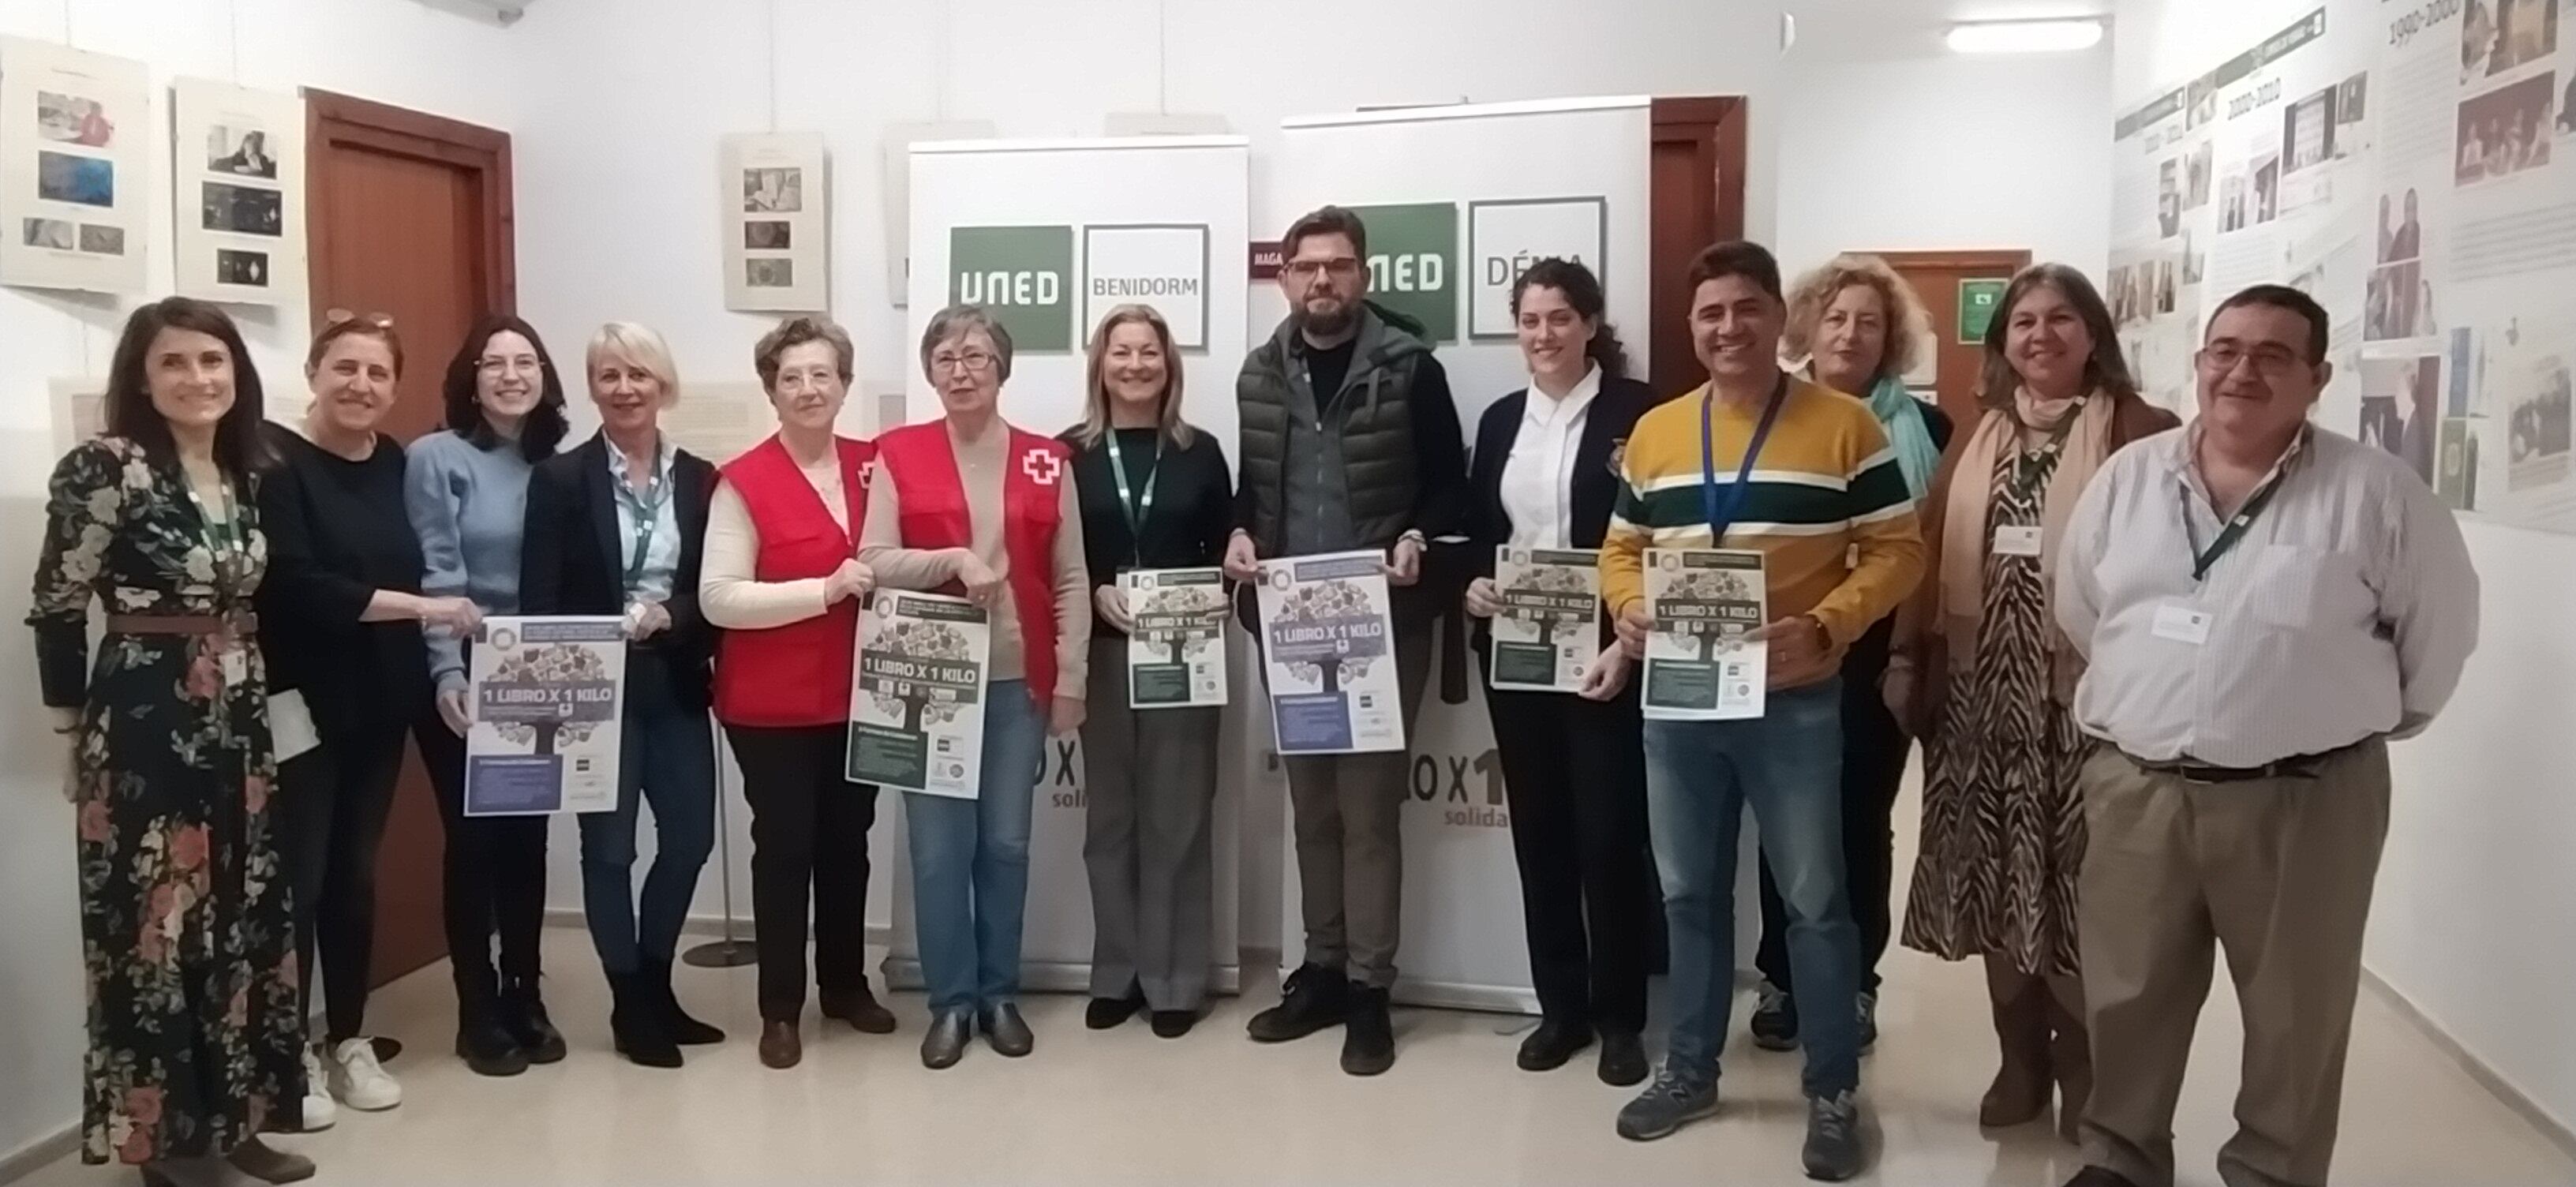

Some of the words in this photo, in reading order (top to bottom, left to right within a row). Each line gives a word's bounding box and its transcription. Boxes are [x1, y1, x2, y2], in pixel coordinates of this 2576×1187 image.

[1366, 253, 1443, 292] NED
[960, 271, 1059, 305] UNED
[1093, 278, 1198, 296] BENIDORM
[1274, 630, 1282, 644] 1
[1285, 627, 1324, 642] LIBRO
[1327, 625, 1336, 639] X
[1339, 625, 1346, 638] 1
[1350, 622, 1382, 638] KILO
[864, 657, 872, 670] 1
[874, 658, 915, 677] LIBRO
[916, 665, 927, 679] X
[930, 667, 938, 680] 1
[942, 668, 975, 683] KILO
[484, 689, 492, 702] 1
[497, 688, 546, 702] LIBRO
[549, 689, 560, 702] X
[564, 689, 572, 702] 1
[577, 687, 612, 702] KILO
[1055, 740, 1075, 786] X
[1447, 755, 1468, 803] X
[1473, 749, 1503, 805] 1
[1445, 807, 1508, 827] solida
